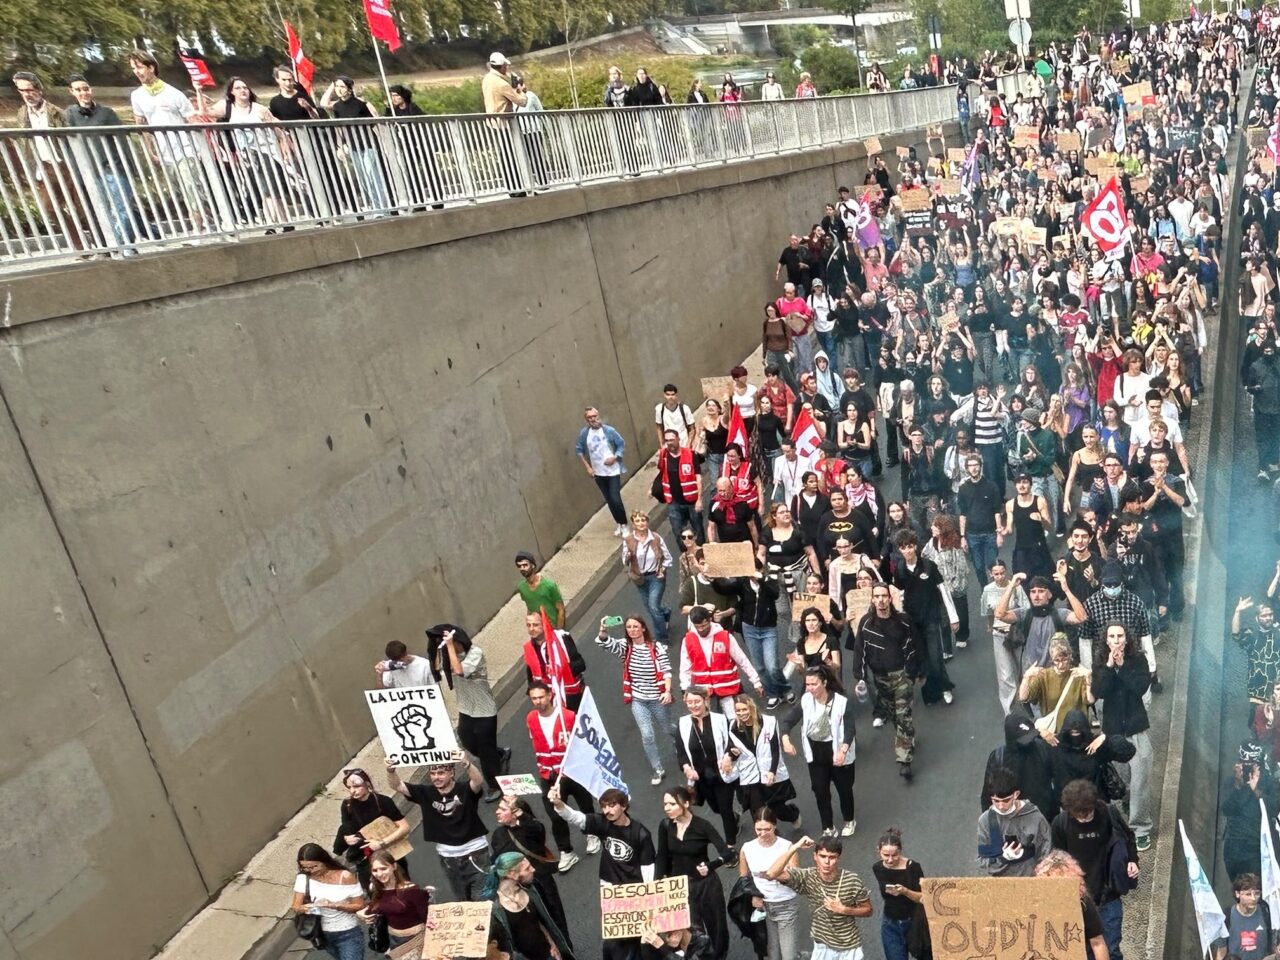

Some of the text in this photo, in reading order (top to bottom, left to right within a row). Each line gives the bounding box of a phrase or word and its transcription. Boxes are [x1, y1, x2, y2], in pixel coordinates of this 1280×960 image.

[369, 688, 437, 704] LA LUTTE
[669, 878, 685, 892] DU
[603, 923, 642, 937] NOTRE
